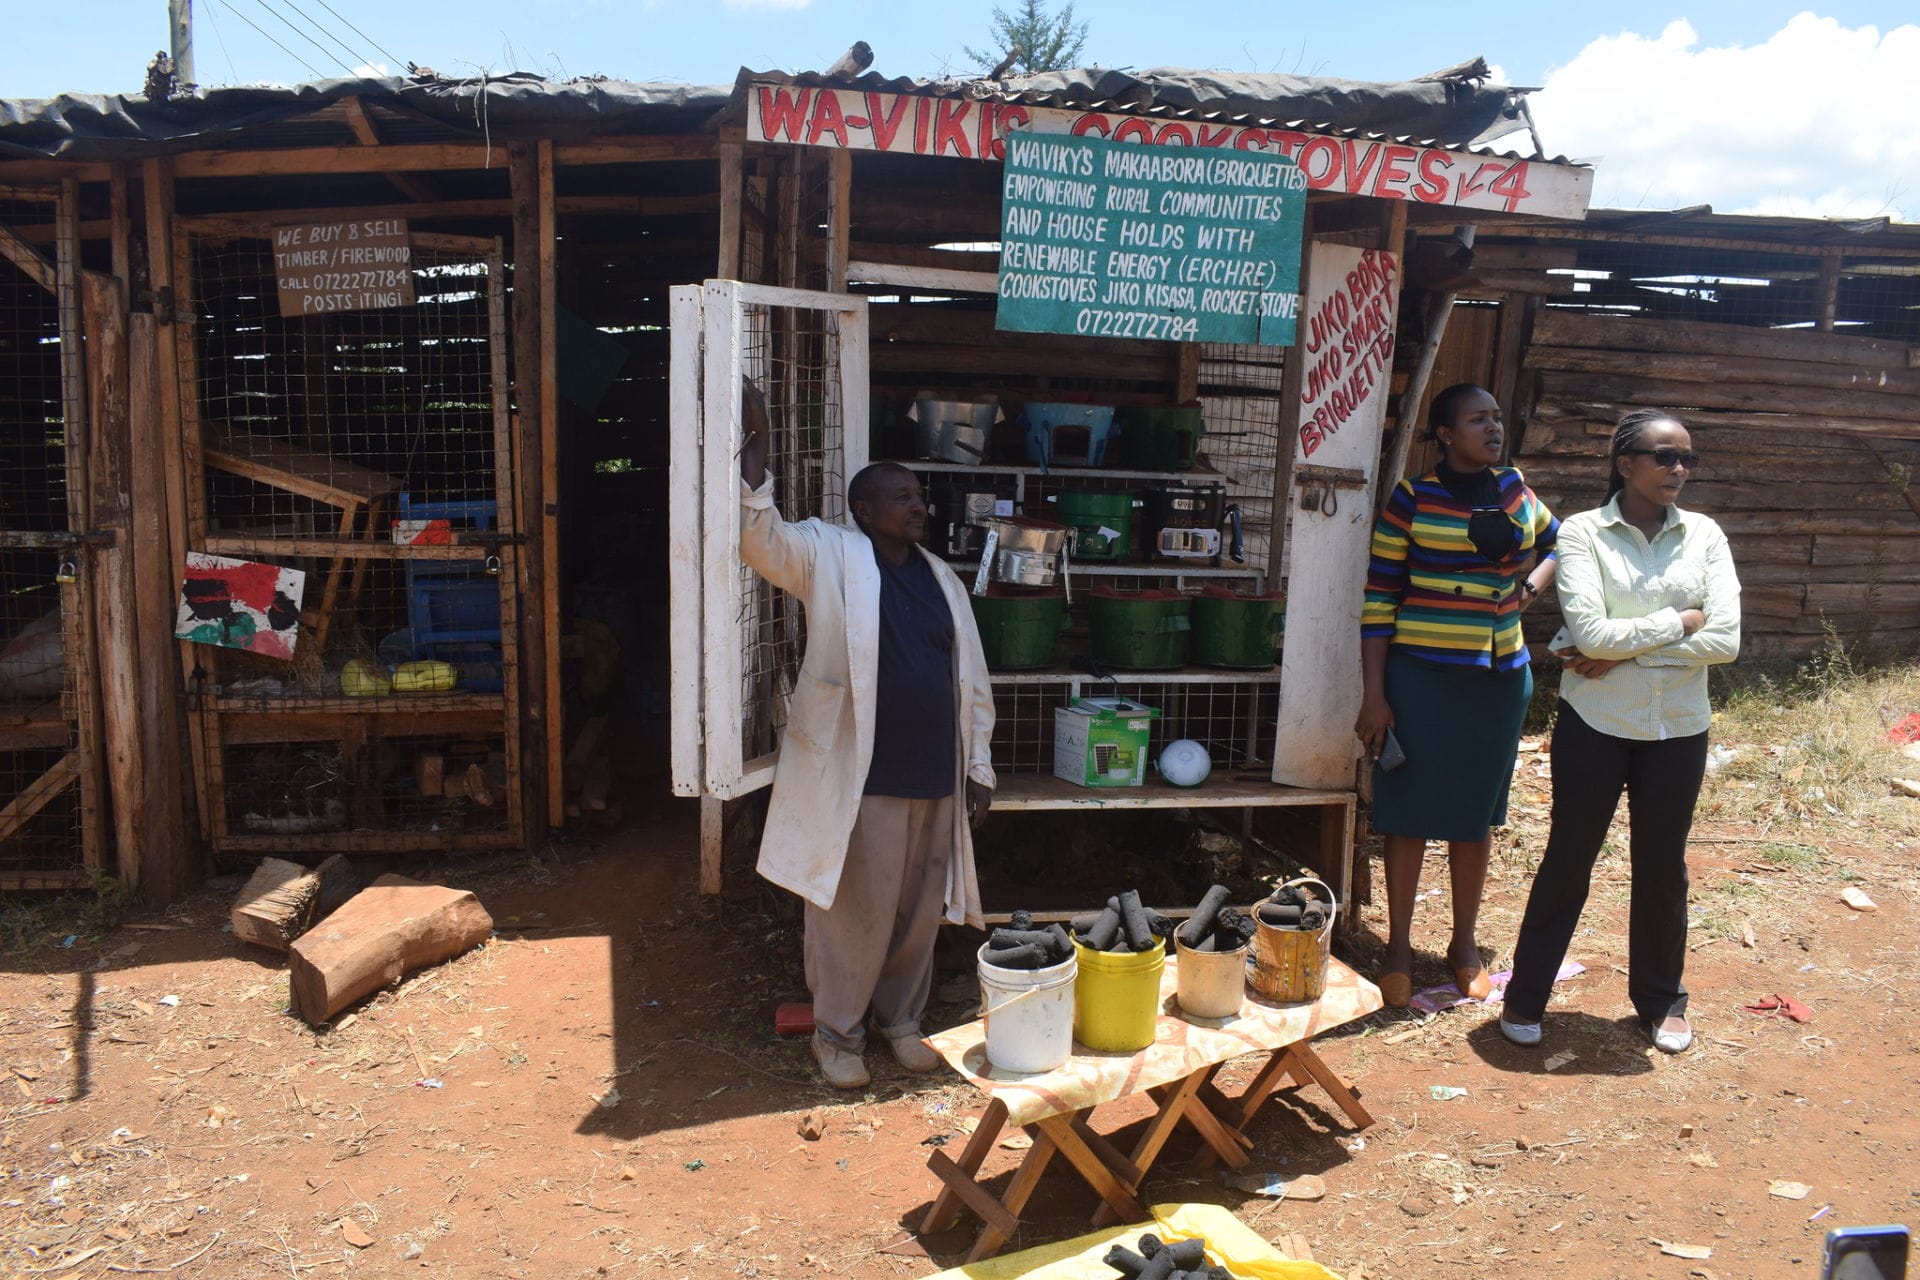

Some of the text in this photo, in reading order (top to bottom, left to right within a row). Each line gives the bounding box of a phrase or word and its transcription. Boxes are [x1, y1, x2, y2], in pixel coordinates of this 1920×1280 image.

[1011, 139, 1094, 177] WAVIKY'S
[1005, 174, 1283, 222] EMPOWERING RURAL COMMUNITIES
[278, 228, 303, 246] WE
[309, 224, 343, 244] BUY
[364, 220, 404, 238] SELL
[1006, 207, 1255, 253] AND HOUSE HOLDS WITH
[313, 269, 409, 291] 0722272784
[1003, 241, 1276, 290] RENEWABLE ENERGY (ERCHRE)
[1000, 272, 1098, 303] COOKSTOVES
[1102, 281, 1140, 307] JIKO
[1201, 287, 1259, 316] ROCKET
[1256, 292, 1299, 319] STOVE
[1306, 249, 1396, 355] JIKO BORA
[1076, 307, 1200, 342] 0722272784
[1301, 345, 1343, 405] JIKO
